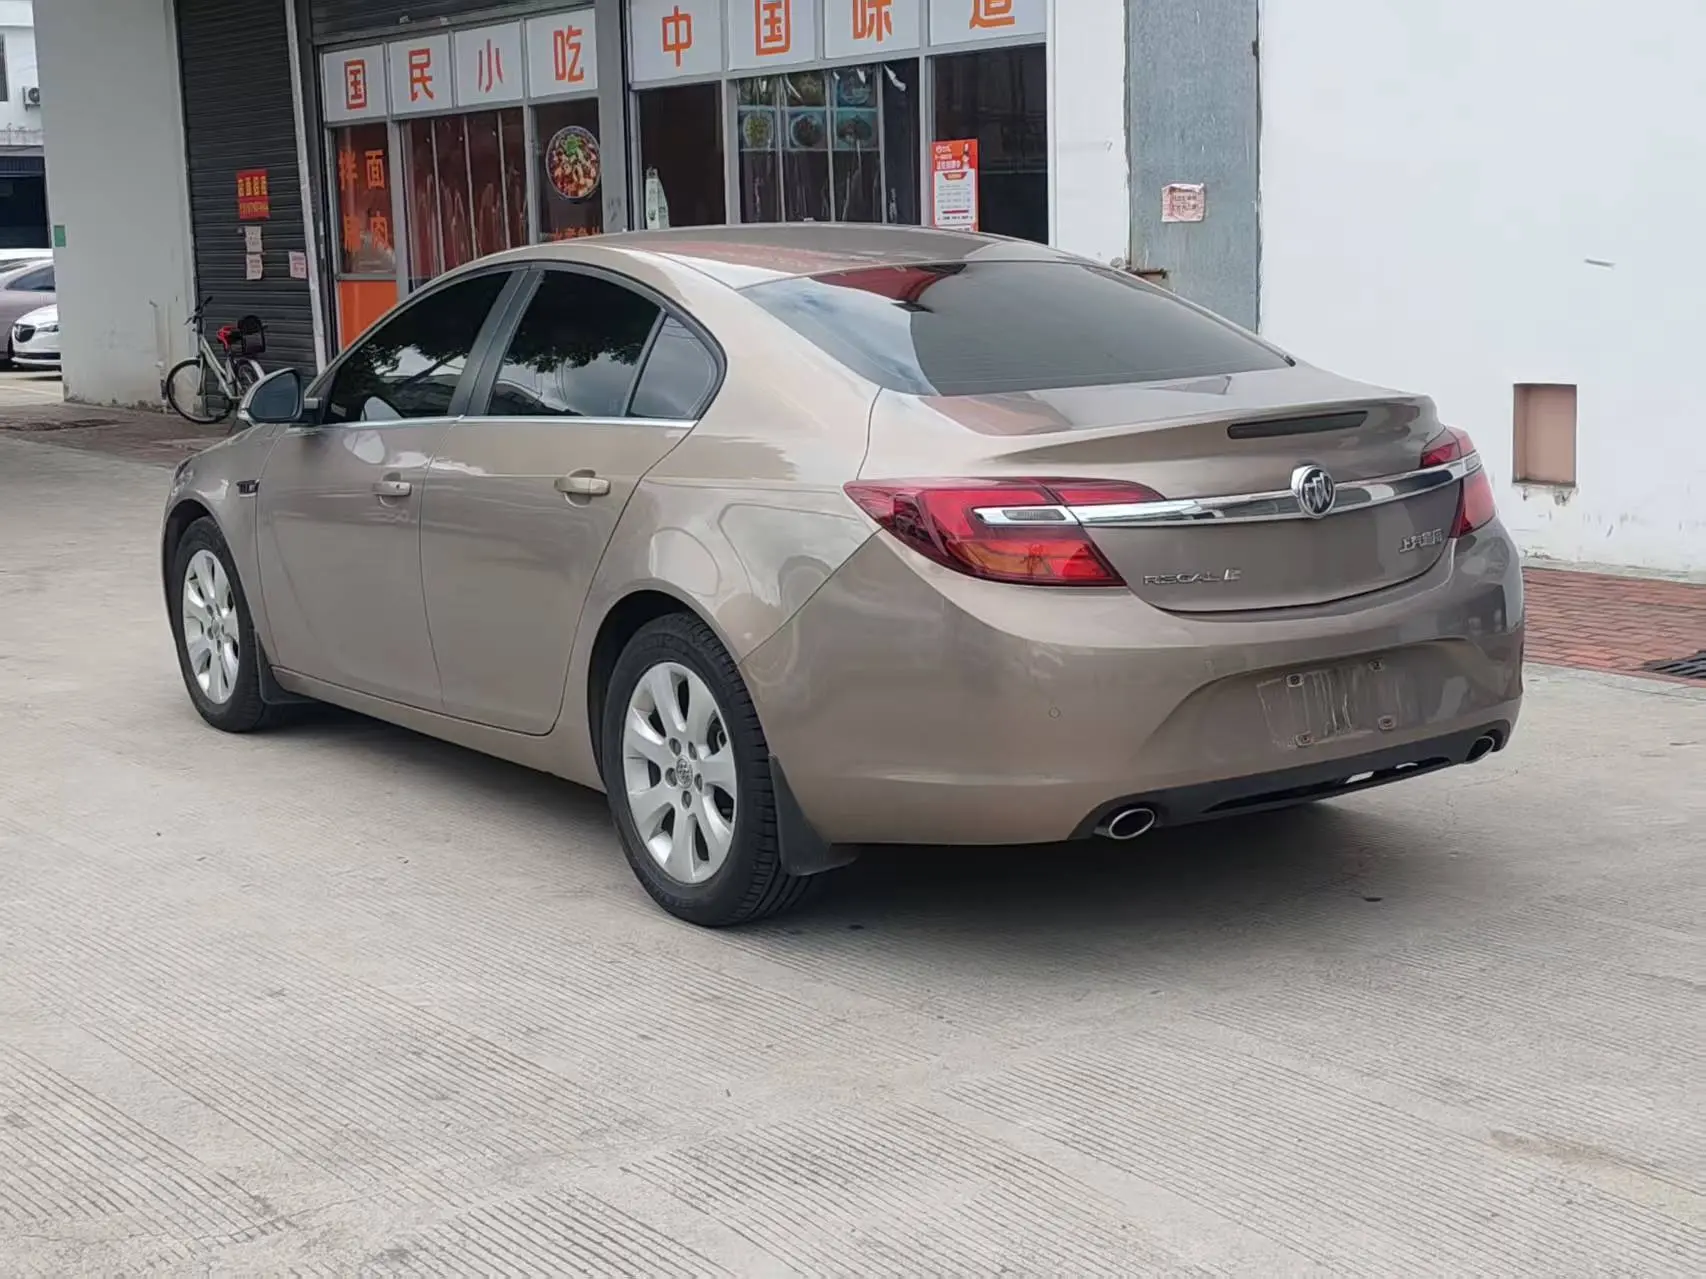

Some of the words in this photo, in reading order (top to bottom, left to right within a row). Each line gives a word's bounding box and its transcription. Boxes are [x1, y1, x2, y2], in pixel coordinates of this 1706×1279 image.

[344, 25, 584, 110] 国民小吃
[1144, 572, 1221, 585] REGAL
